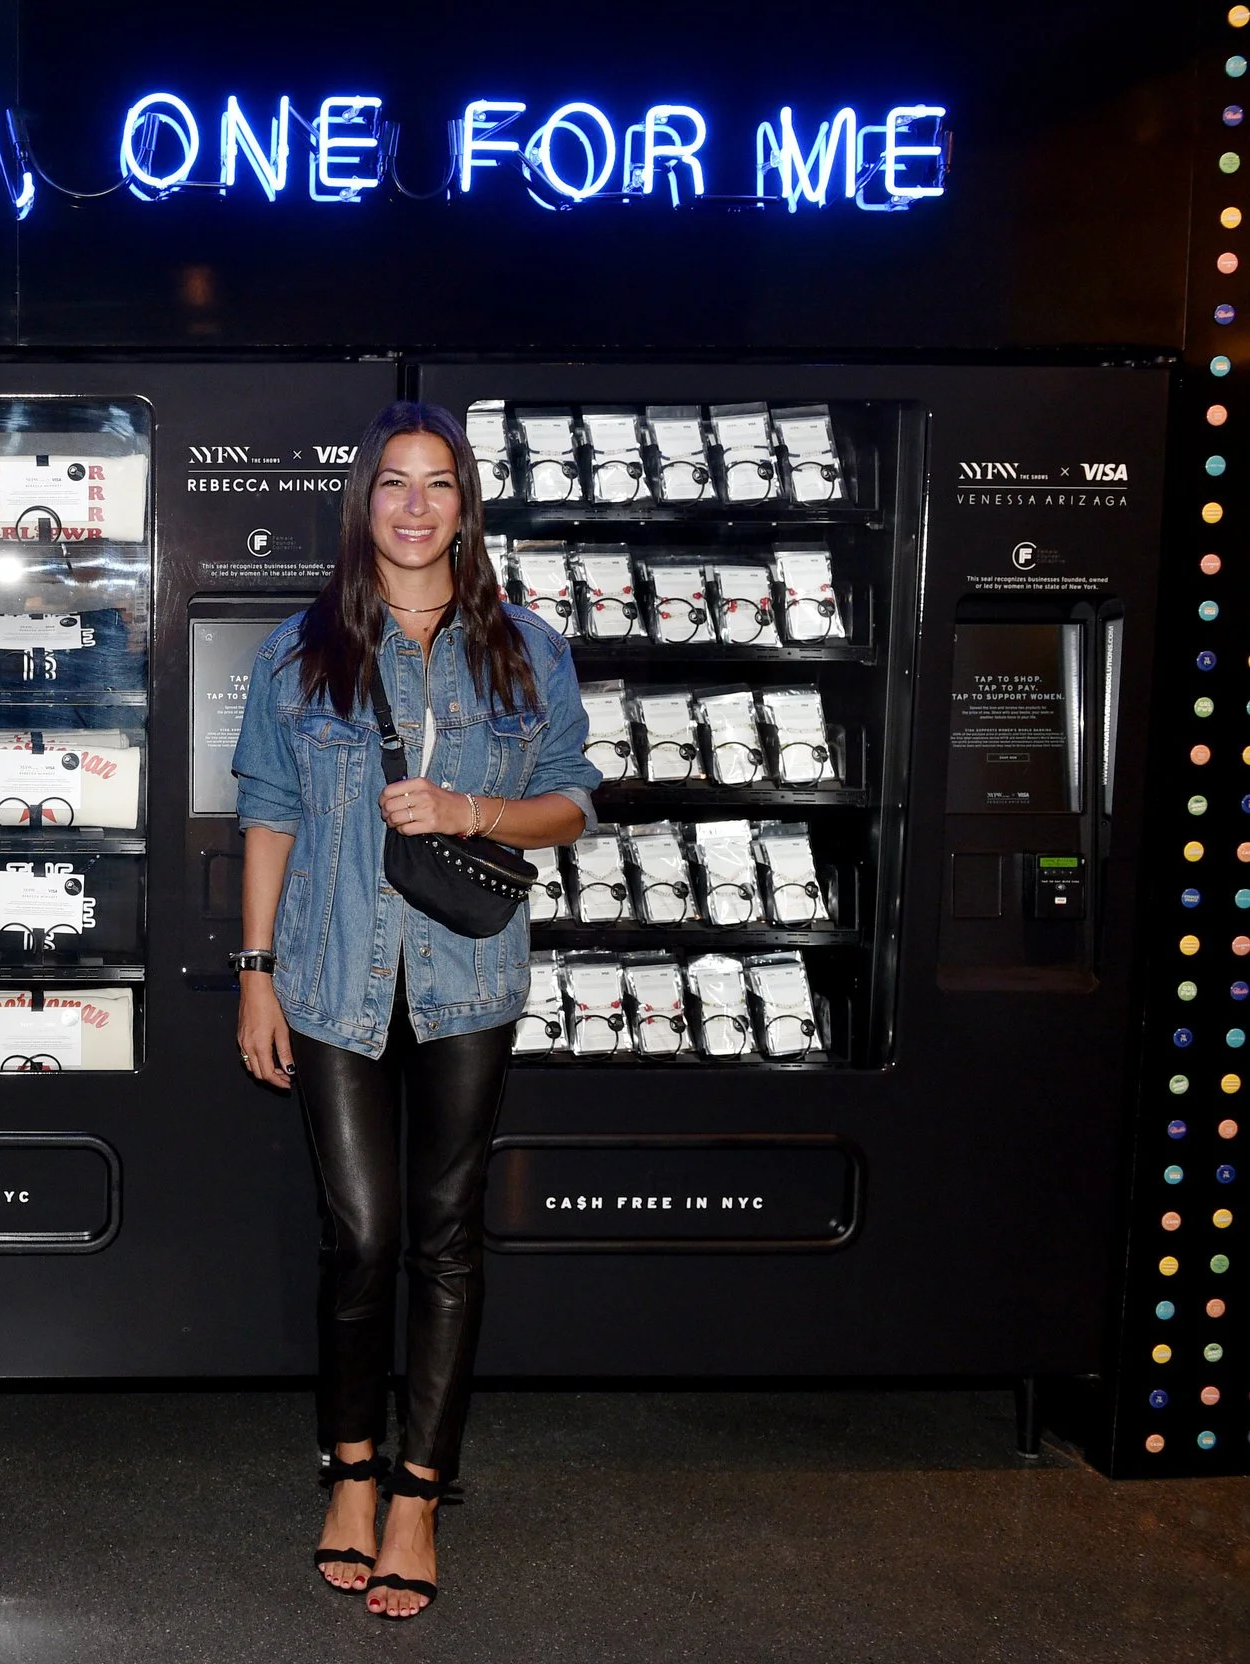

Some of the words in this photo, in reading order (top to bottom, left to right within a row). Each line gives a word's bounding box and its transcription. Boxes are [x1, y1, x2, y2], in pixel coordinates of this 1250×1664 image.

[122, 92, 382, 190] ONE
[463, 99, 707, 198] FOR
[779, 104, 945, 200] ME
[1080, 463, 1129, 481] VISA
[187, 478, 270, 492] REBECCA
[279, 478, 348, 492] MINKO
[957, 494, 1037, 505] VENESSA
[1045, 495, 1128, 507] ARIZAGA
[230, 563, 263, 571] recognizes
[230, 570, 238, 578] by
[994, 583, 1002, 591] by
[545, 1196, 603, 1210] CA$H
[617, 1197, 673, 1209] FREE
[686, 1197, 708, 1209] IN
[721, 1197, 764, 1209] NYC
